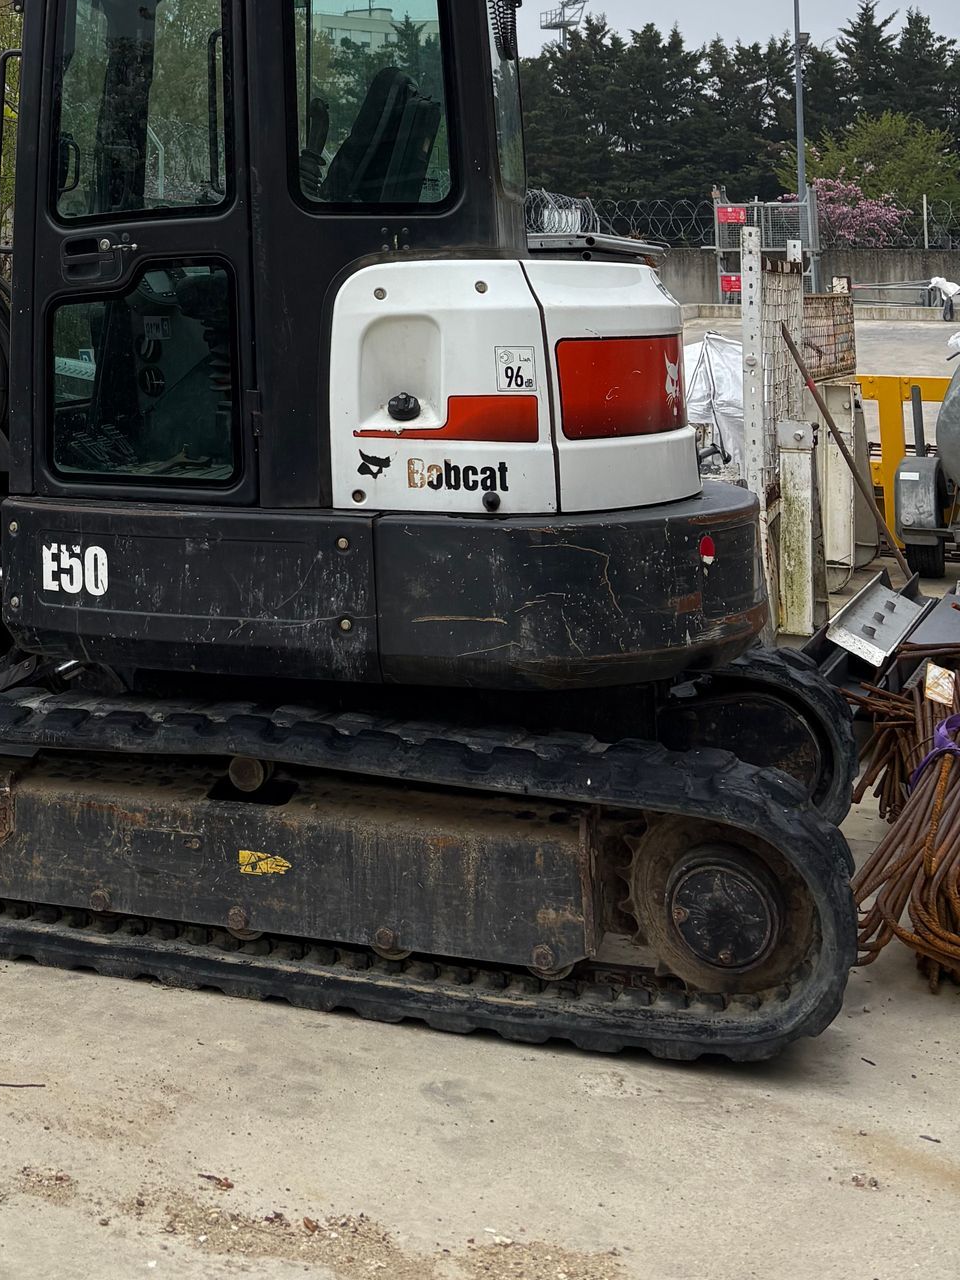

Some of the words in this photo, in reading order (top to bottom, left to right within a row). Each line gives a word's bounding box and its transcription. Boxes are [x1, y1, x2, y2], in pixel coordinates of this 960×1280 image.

[505, 365, 524, 387] 96
[524, 378, 533, 387] dB
[407, 457, 509, 491] Bobcat
[42, 542, 108, 596] E50
